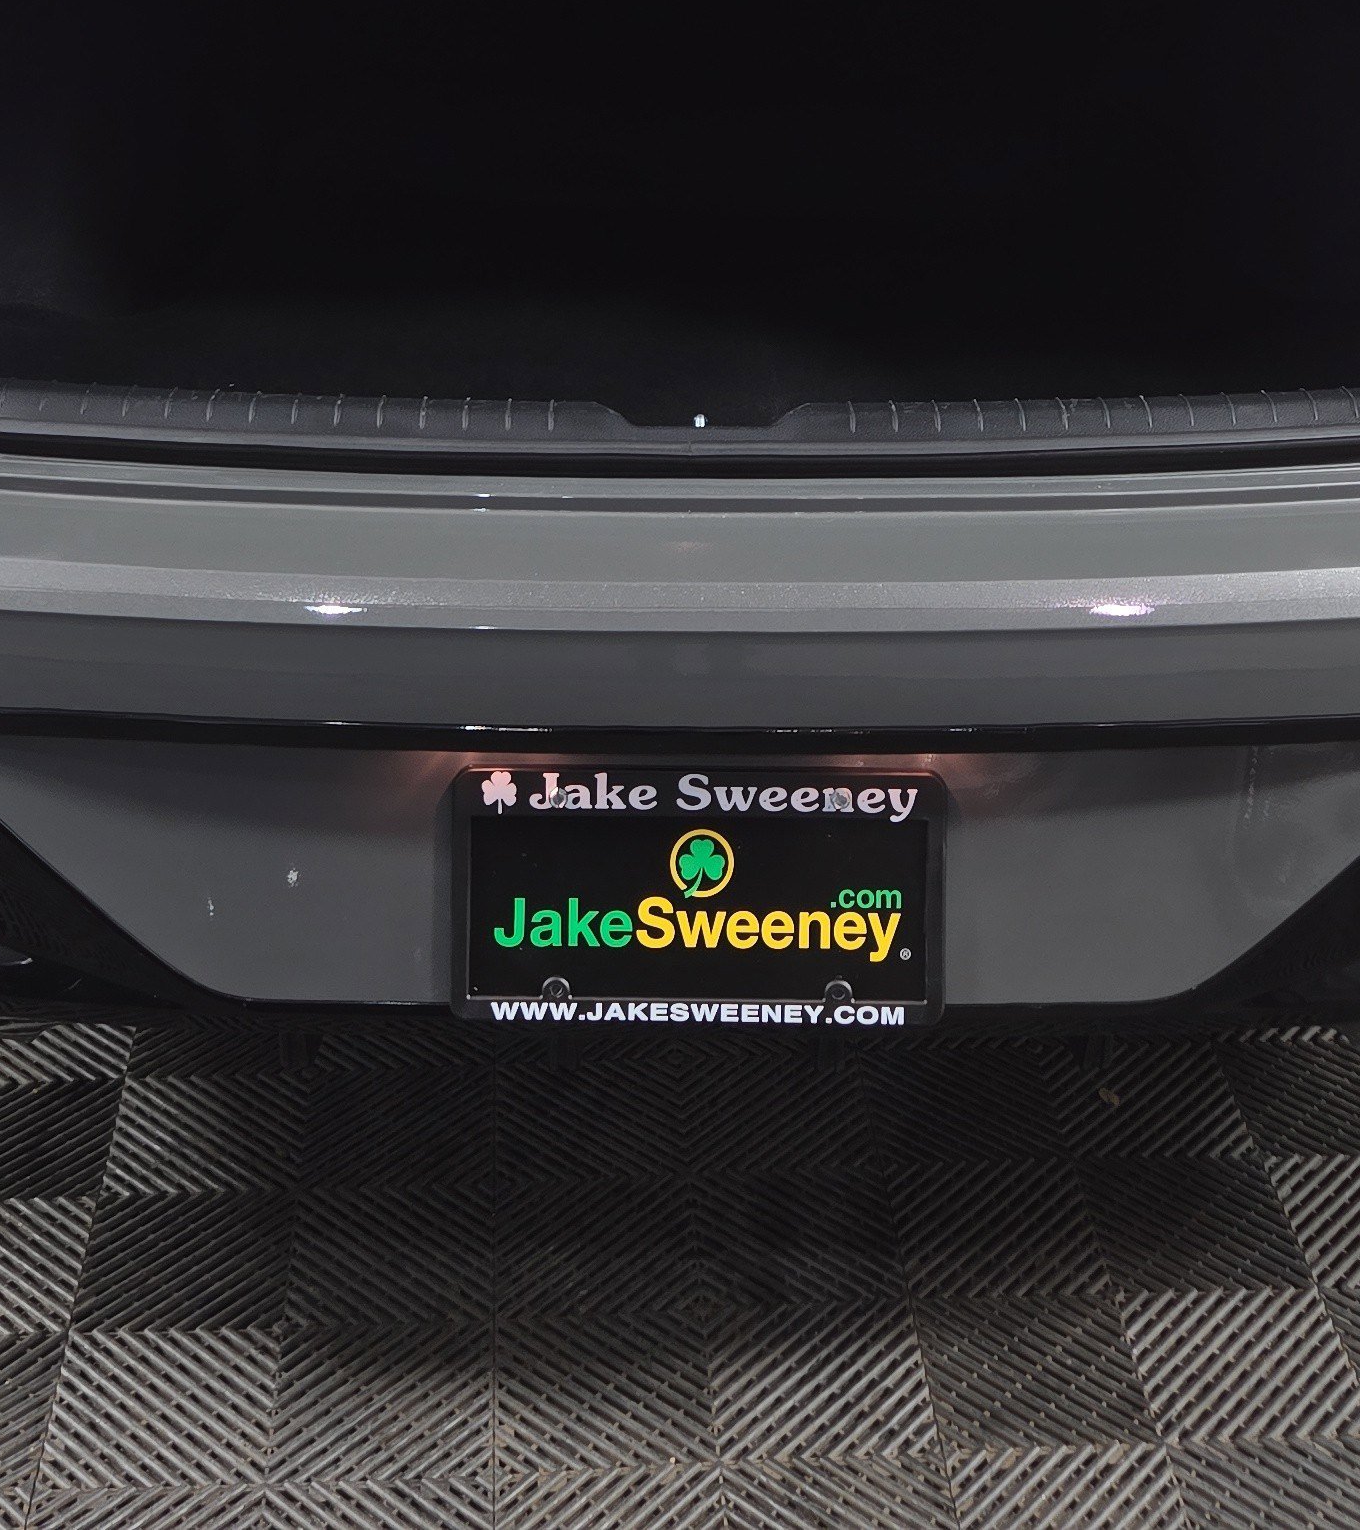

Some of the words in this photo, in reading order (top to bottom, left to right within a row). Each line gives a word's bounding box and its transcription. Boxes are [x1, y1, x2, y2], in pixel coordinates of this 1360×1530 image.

[528, 772, 658, 811] Jake
[675, 772, 919, 824] Sweeney
[490, 1001, 906, 1026] WWW.JAKESWEENEY.COM
